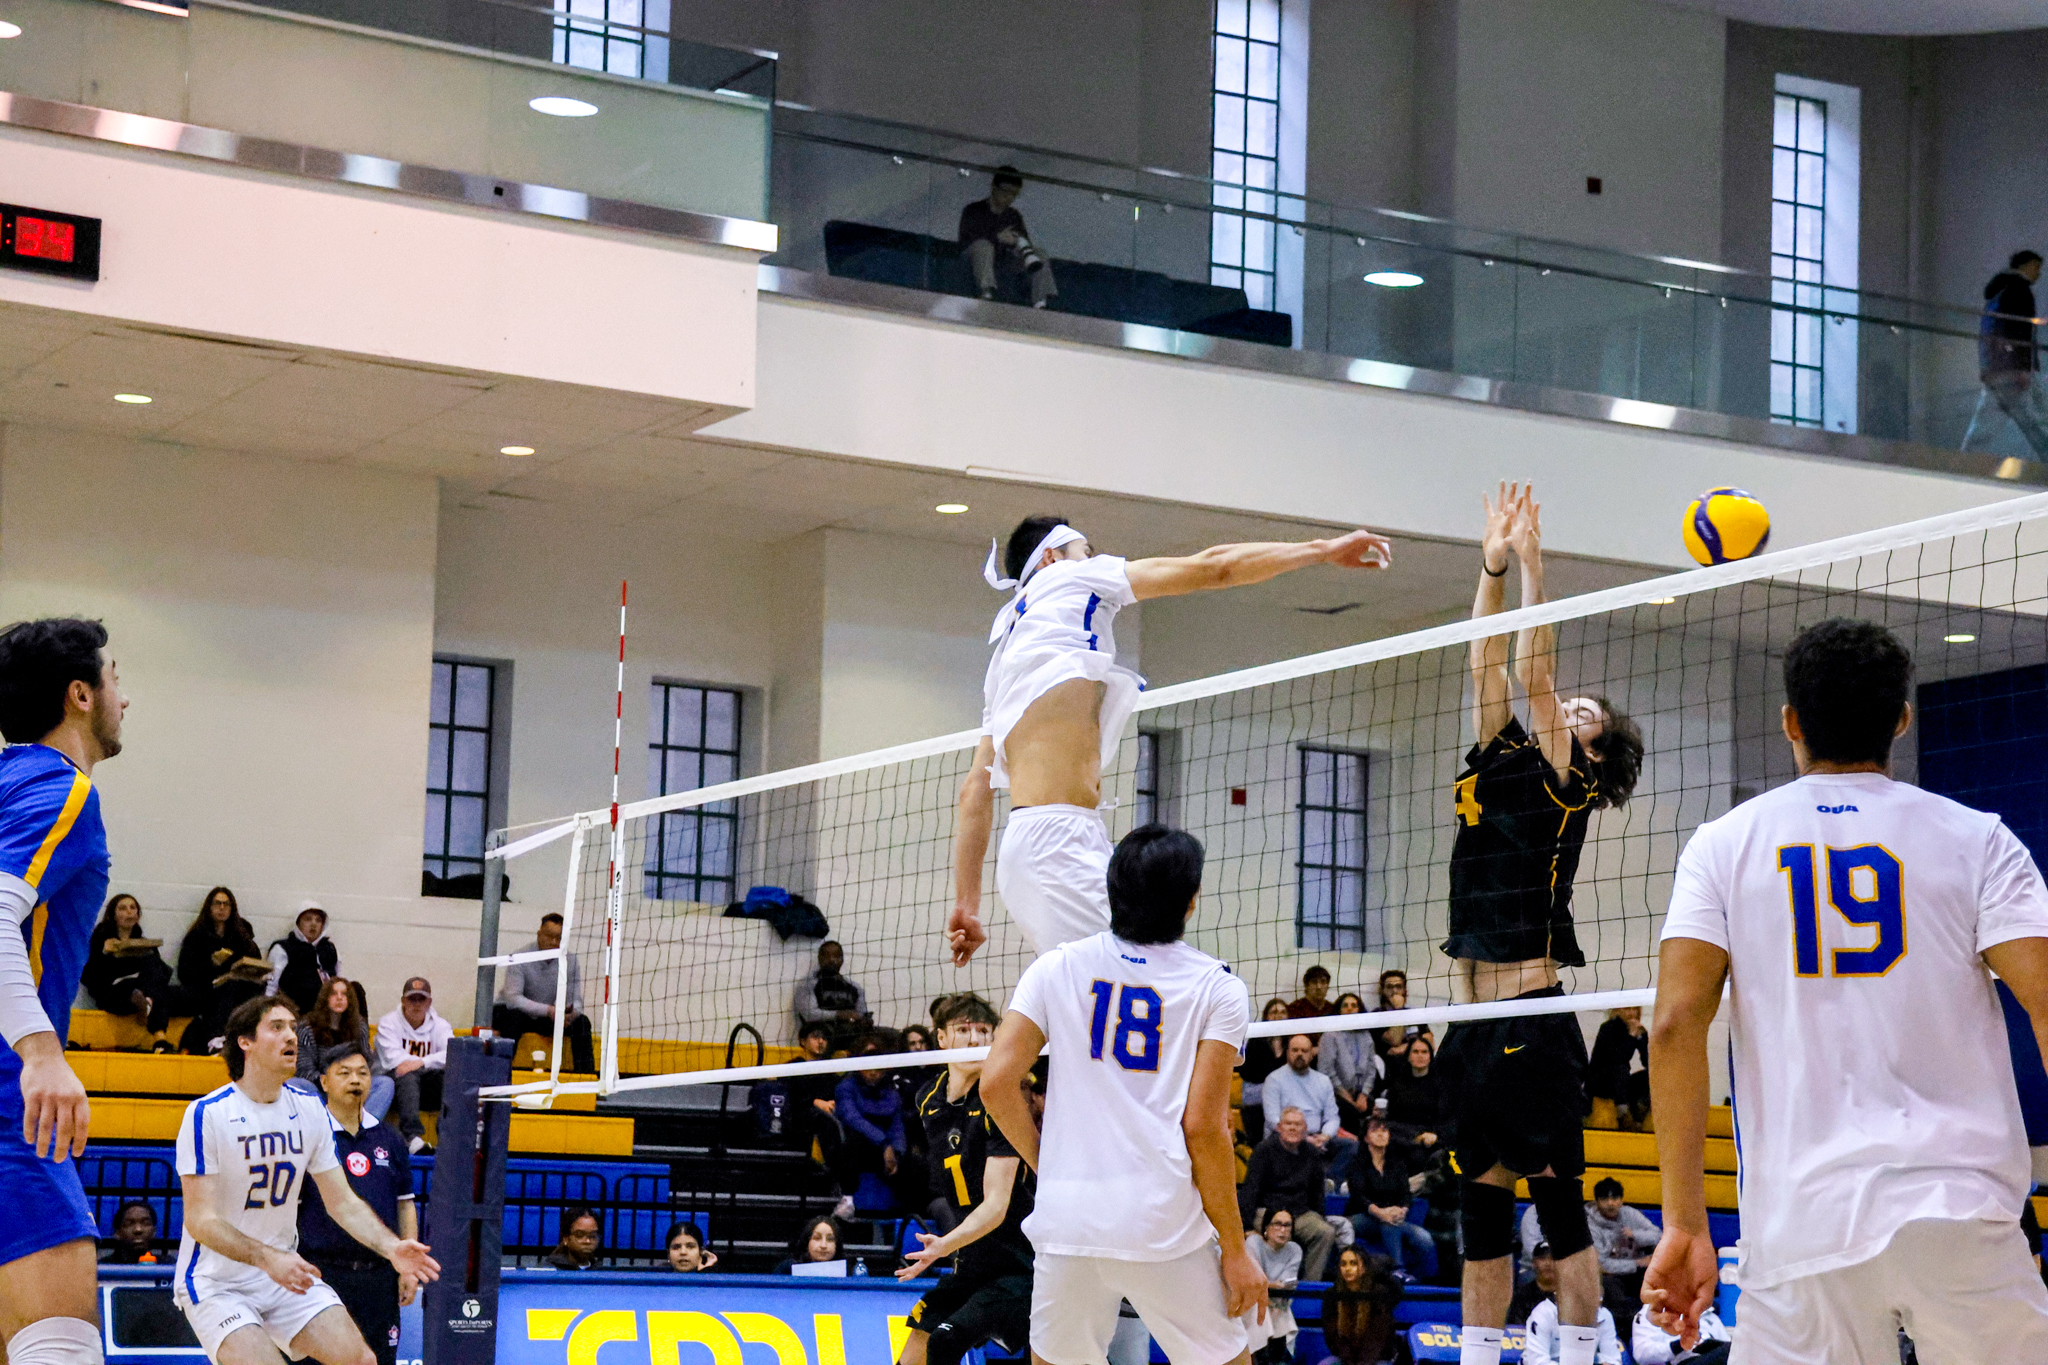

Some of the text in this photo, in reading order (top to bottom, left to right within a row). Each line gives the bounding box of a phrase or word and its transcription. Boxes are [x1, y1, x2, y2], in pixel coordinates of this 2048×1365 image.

[1816, 804, 1860, 815] OUA
[1776, 841, 1909, 979] 19
[1089, 977, 1165, 1074] 18
[237, 1129, 304, 1160] TMU
[244, 1161, 297, 1210] 20
[943, 1154, 972, 1207] 1
[218, 1312, 242, 1329] TMU
